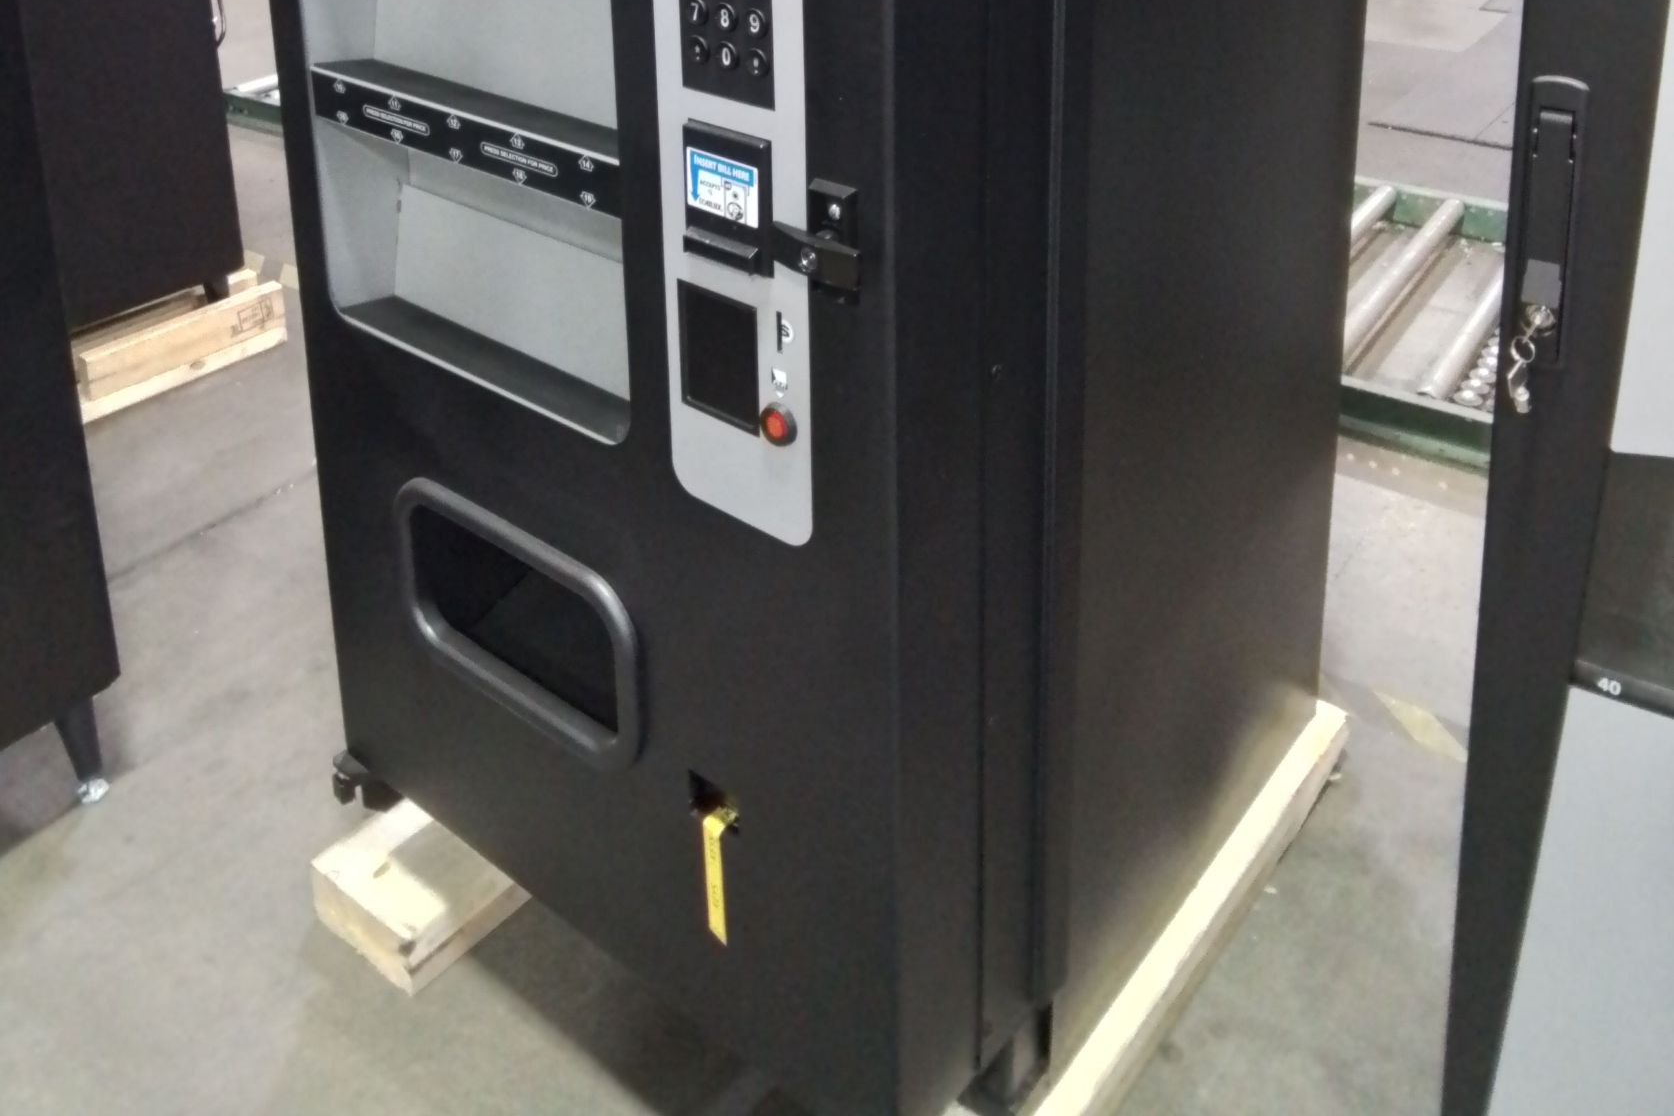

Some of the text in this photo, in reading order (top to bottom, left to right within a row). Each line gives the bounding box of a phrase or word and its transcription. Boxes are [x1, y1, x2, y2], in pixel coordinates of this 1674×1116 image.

[690, 2, 760, 33] 7 8 9
[721, 47, 731, 66] 0
[1597, 677, 1621, 695] 40
